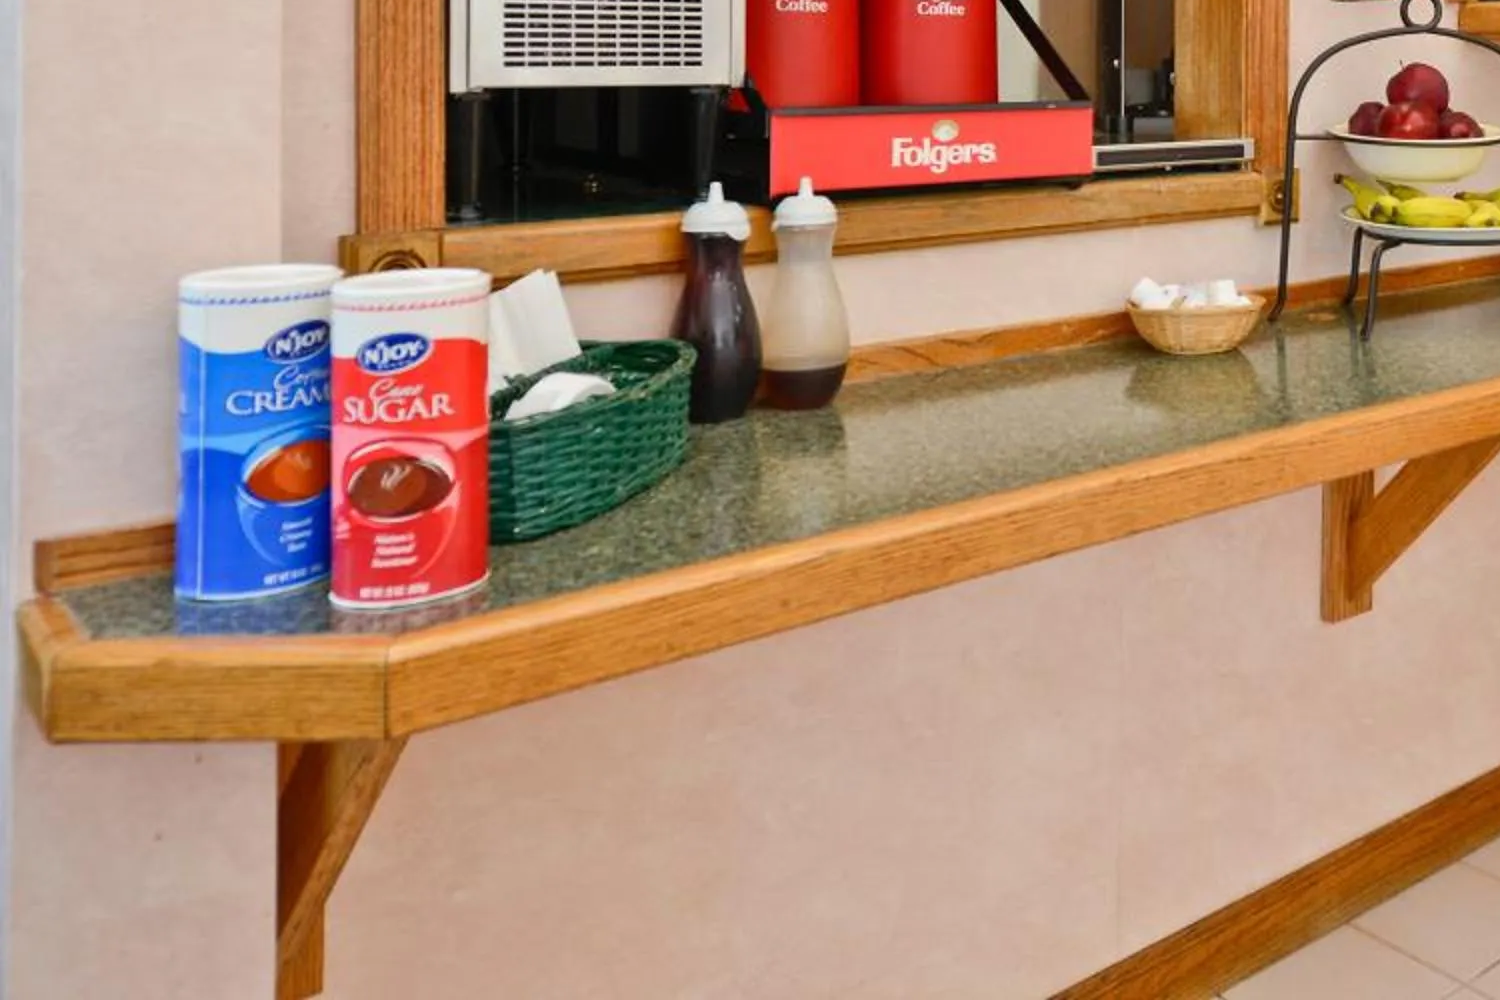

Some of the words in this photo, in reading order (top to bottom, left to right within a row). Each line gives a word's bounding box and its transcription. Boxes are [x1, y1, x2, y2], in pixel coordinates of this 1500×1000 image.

[917, 1, 965, 16] Coffee
[891, 137, 997, 174] Folgers
[343, 393, 455, 425] SUGAR
